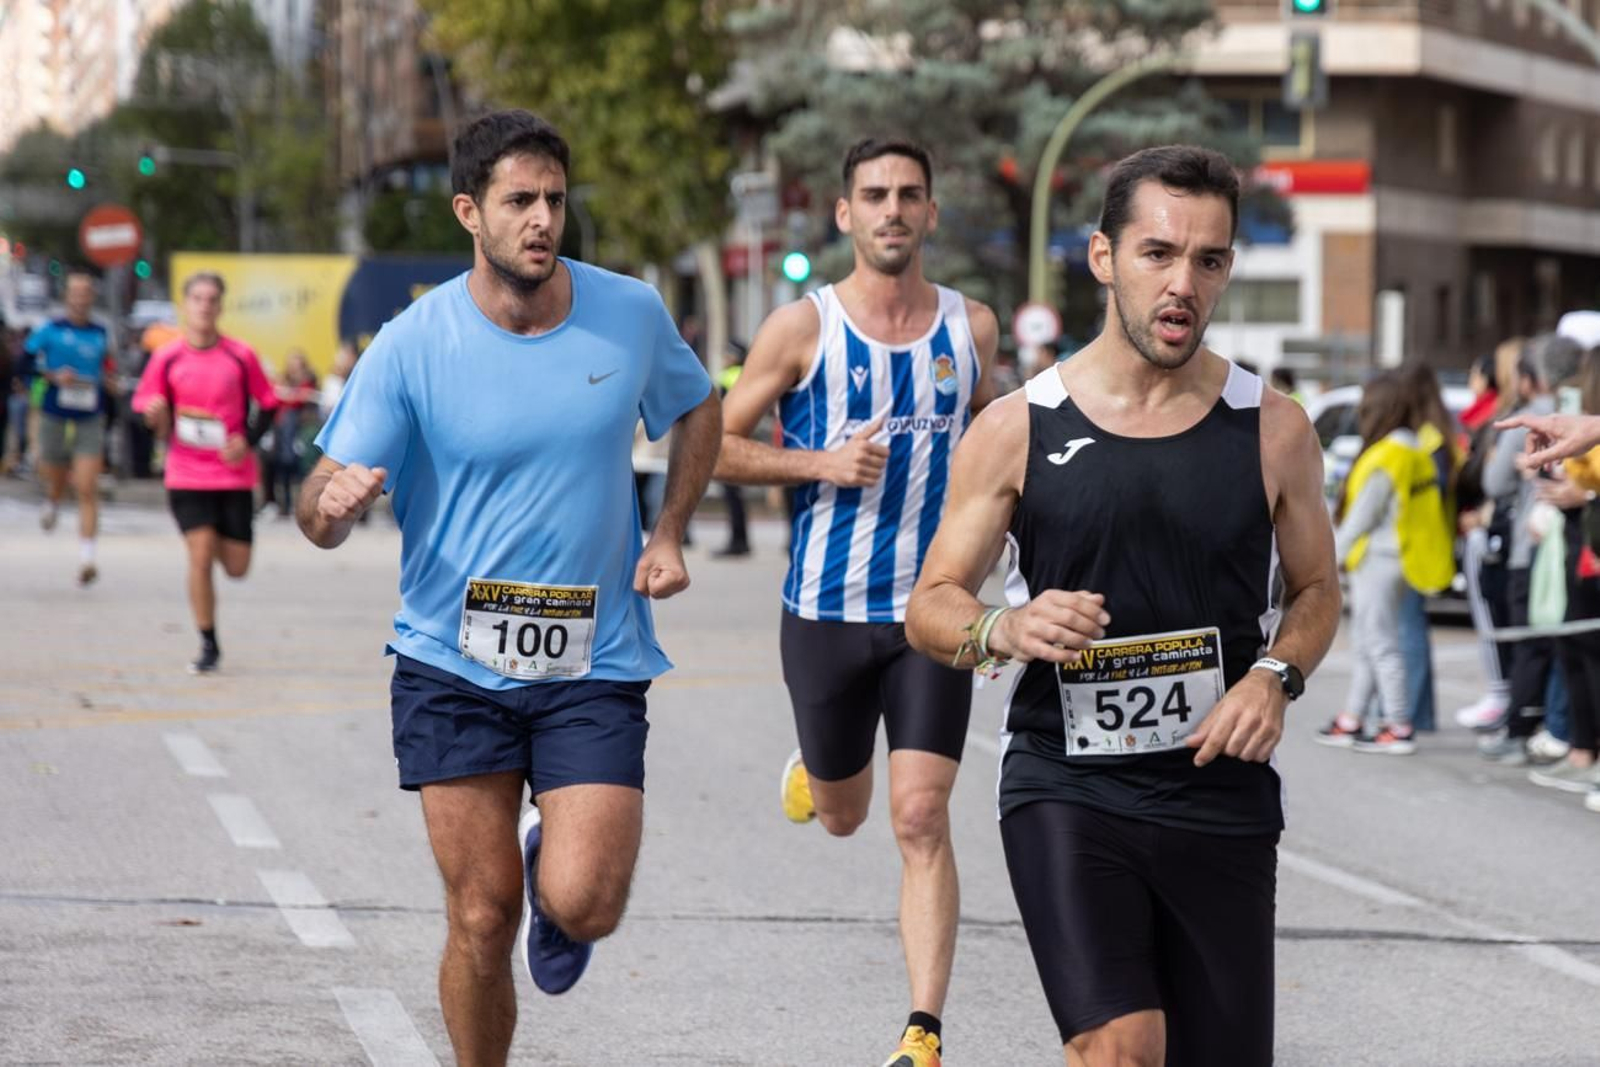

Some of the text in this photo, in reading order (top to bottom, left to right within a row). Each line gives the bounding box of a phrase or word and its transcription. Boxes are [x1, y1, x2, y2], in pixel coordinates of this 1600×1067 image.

[471, 583, 501, 601] XXV
[502, 586, 592, 600] CARRERA POPULAR
[513, 595, 540, 605] gran
[545, 597, 592, 607] caminata
[492, 620, 568, 659] 100
[1096, 637, 1205, 658] CARRERA POPULA
[1096, 646, 1213, 669] y gran caminata
[1095, 680, 1192, 732] 524
